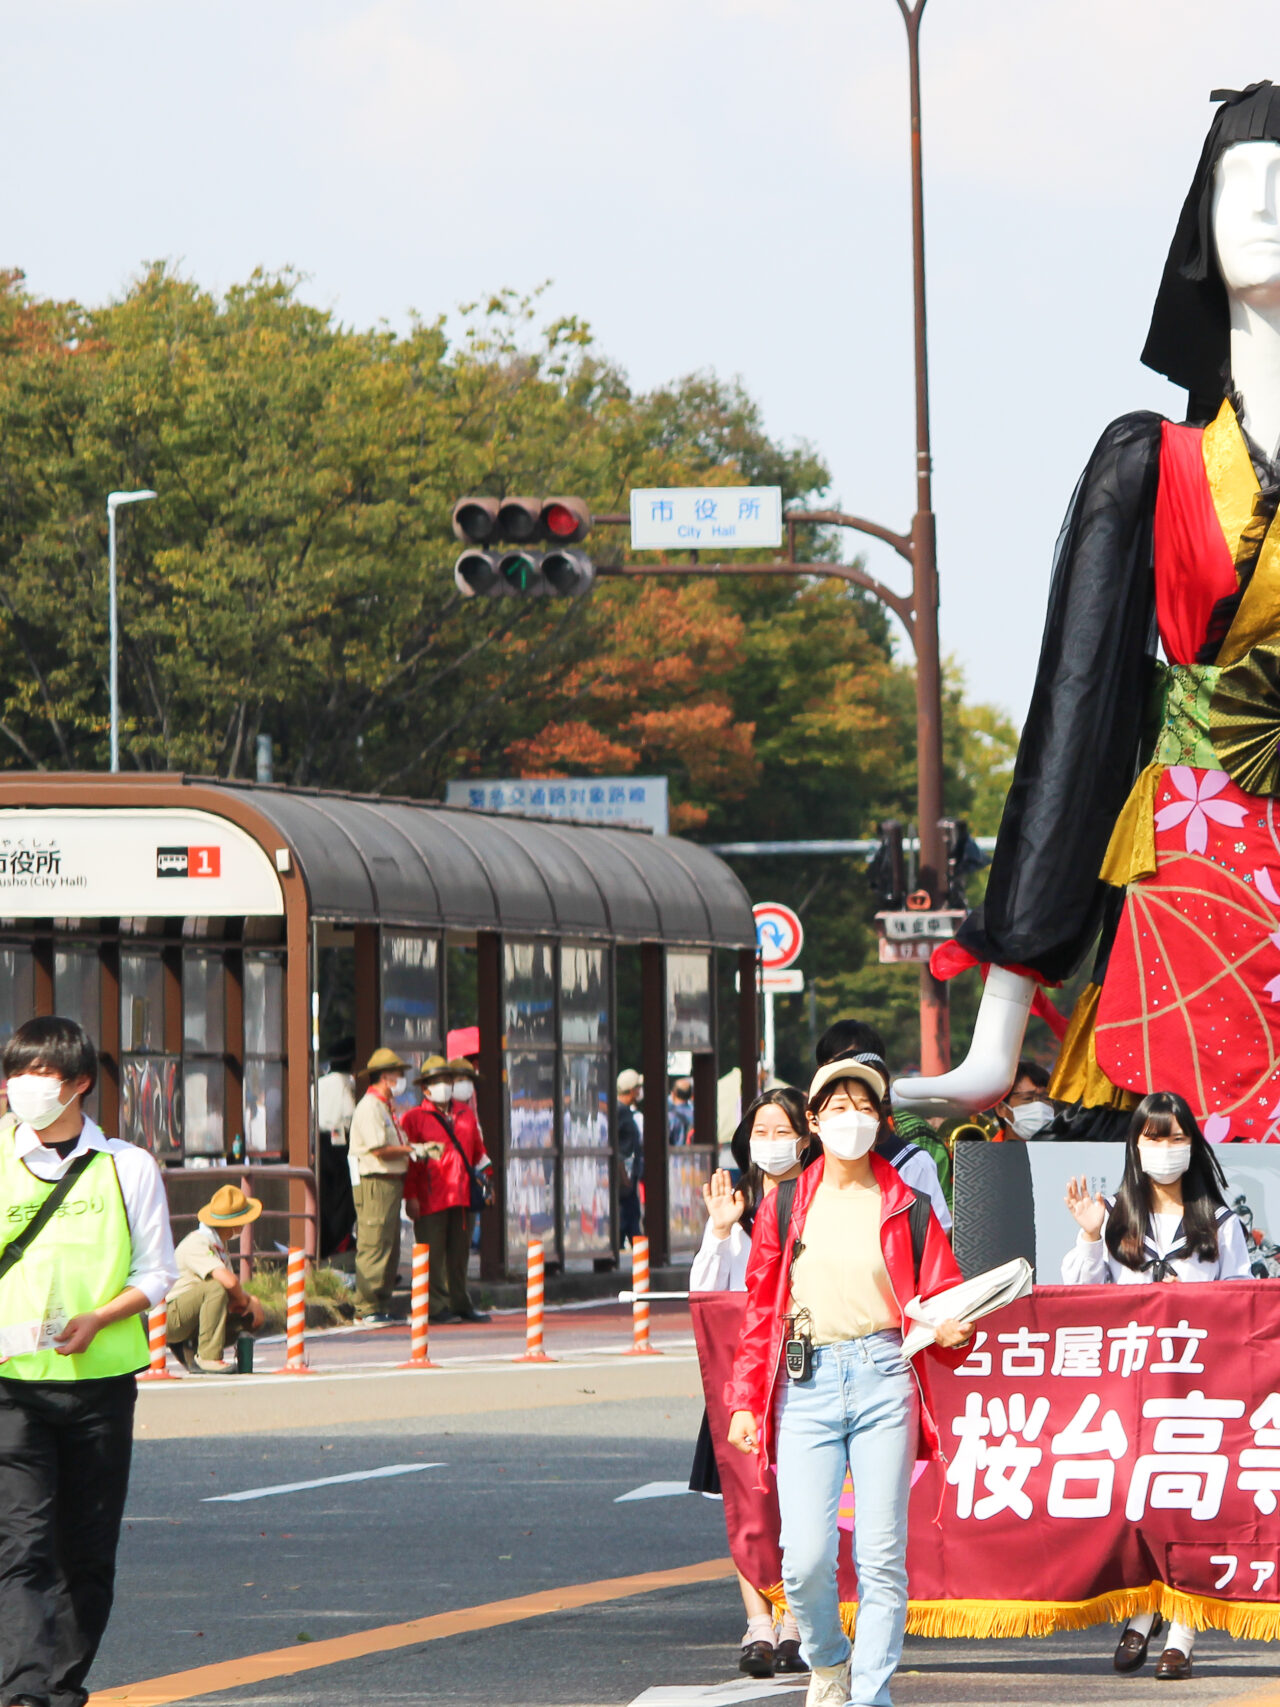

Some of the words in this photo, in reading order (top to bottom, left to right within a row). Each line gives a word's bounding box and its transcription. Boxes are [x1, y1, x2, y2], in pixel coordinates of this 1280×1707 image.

[650, 498, 760, 522] 市役所
[677, 525, 701, 539] City
[712, 525, 735, 537] Hall
[197, 850, 212, 874] 1
[30, 876, 56, 888] (City
[60, 876, 87, 887] Hall)
[7, 1196, 104, 1222] 名古まつり
